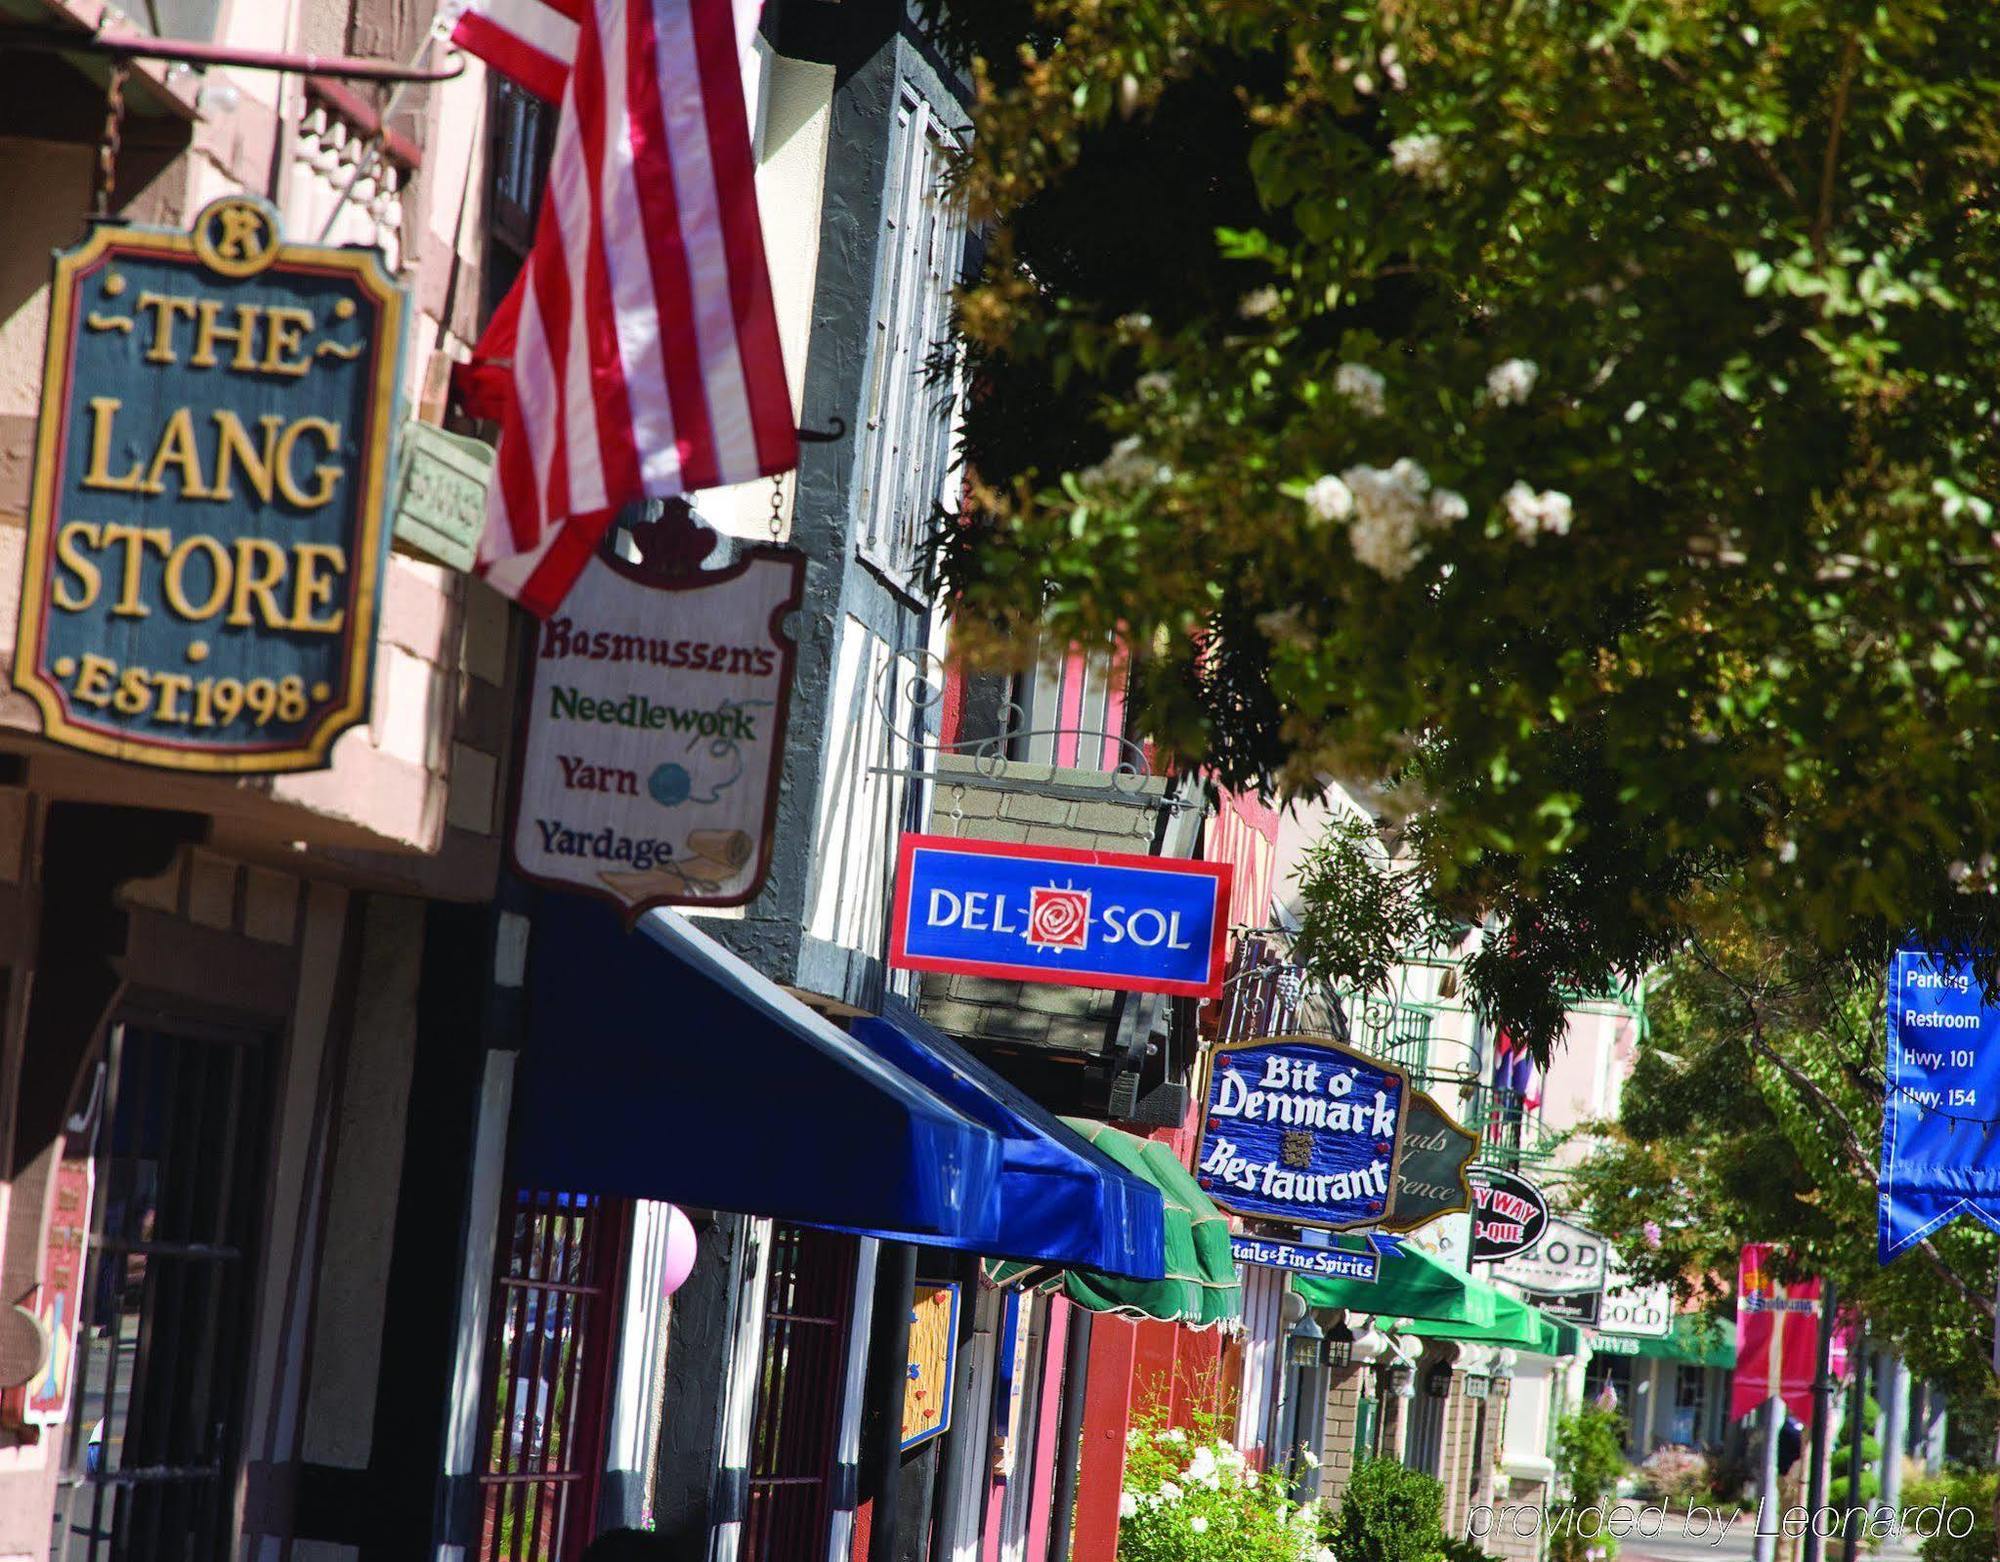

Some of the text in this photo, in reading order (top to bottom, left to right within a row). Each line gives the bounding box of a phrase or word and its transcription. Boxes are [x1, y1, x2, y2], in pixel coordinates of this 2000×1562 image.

[138, 292, 316, 376] THE
[82, 397, 344, 509] LANG
[53, 521, 346, 634] STORE
[540, 616, 776, 678] Rasmussen's
[549, 685, 757, 741] Needlework
[557, 754, 639, 797] Yarn
[536, 818, 674, 870] Yardage
[927, 887, 1192, 950] DEL SOL
[1906, 970, 1969, 994] Parking
[1905, 1009, 1980, 1029] Restroom
[1258, 1055, 1360, 1098] Bit o'
[1903, 1048, 1974, 1070] Hwy. 101
[1210, 1069, 1396, 1139] Denmark
[1902, 1086, 1976, 1109] Hwy. 154
[1402, 1129, 1447, 1151] earls
[1200, 1137, 1389, 1203] Restaurant
[1492, 1189, 1541, 1226] WAY
